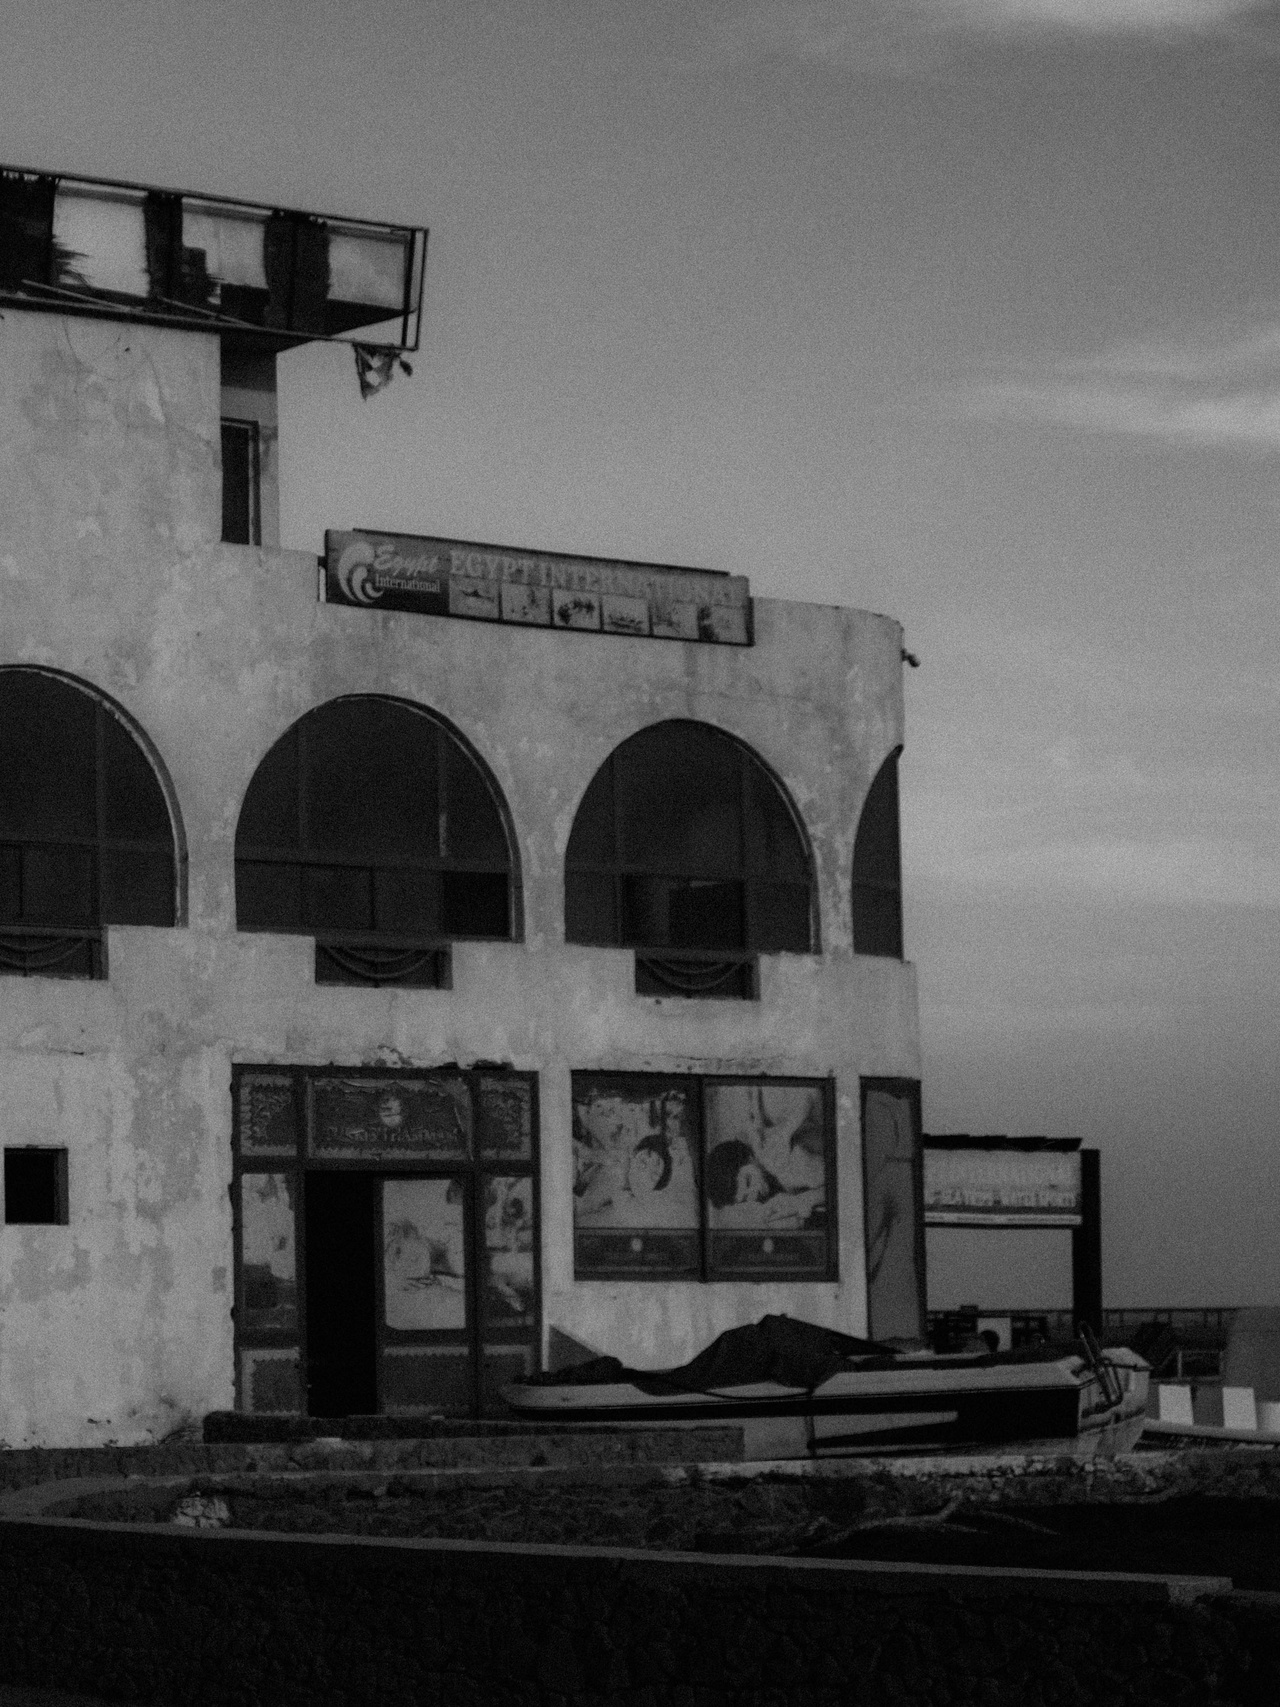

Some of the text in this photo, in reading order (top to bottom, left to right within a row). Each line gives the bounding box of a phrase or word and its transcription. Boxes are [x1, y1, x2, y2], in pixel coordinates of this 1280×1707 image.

[374, 544, 438, 577] Egypt
[450, 550, 534, 583] EGYPT
[375, 574, 440, 593] International
